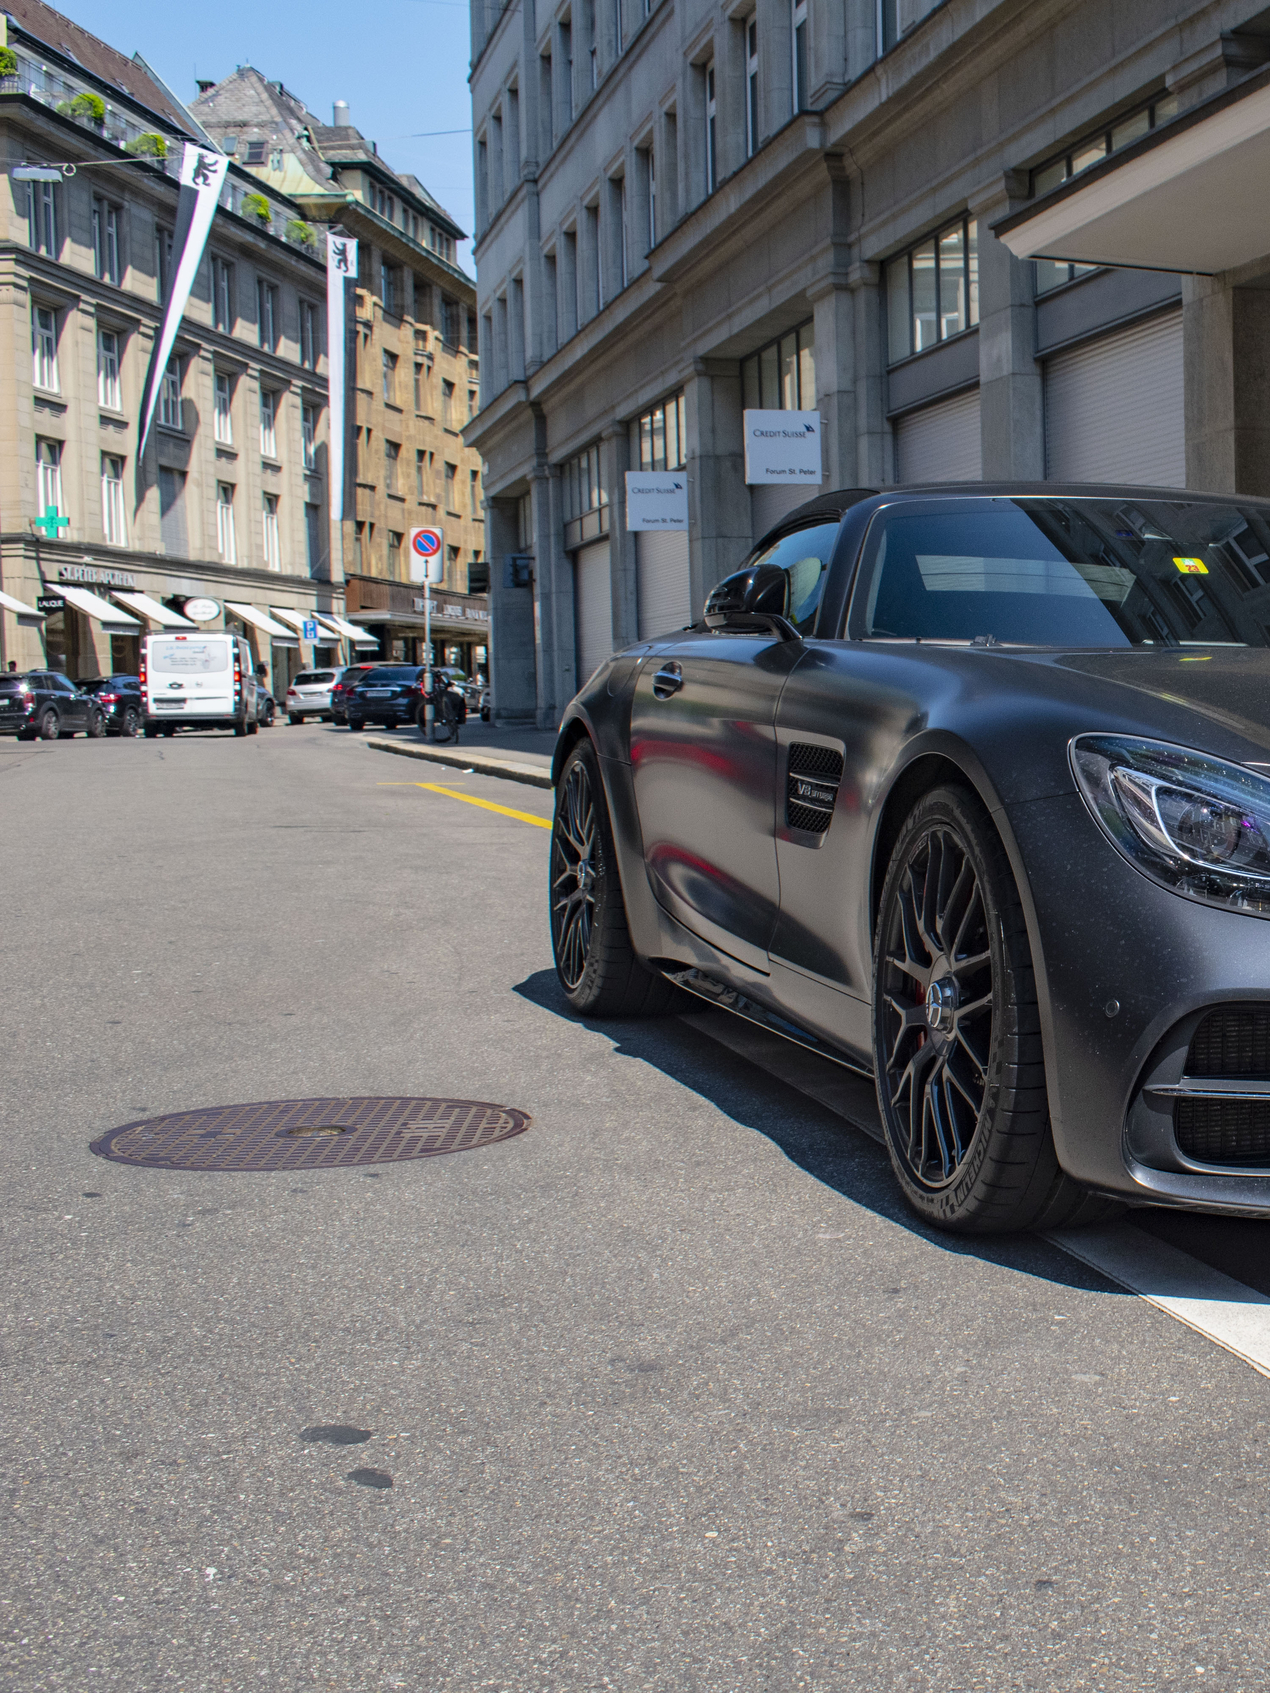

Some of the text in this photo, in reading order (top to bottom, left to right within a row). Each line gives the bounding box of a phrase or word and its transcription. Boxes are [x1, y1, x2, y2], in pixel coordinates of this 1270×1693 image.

[753, 428, 807, 439] CREDIT SUISSE
[765, 467, 787, 475] Forum
[799, 468, 817, 476] Peter
[631, 486, 676, 494] CREDIT SUISSE
[38, 599, 64, 608] LALIQUE
